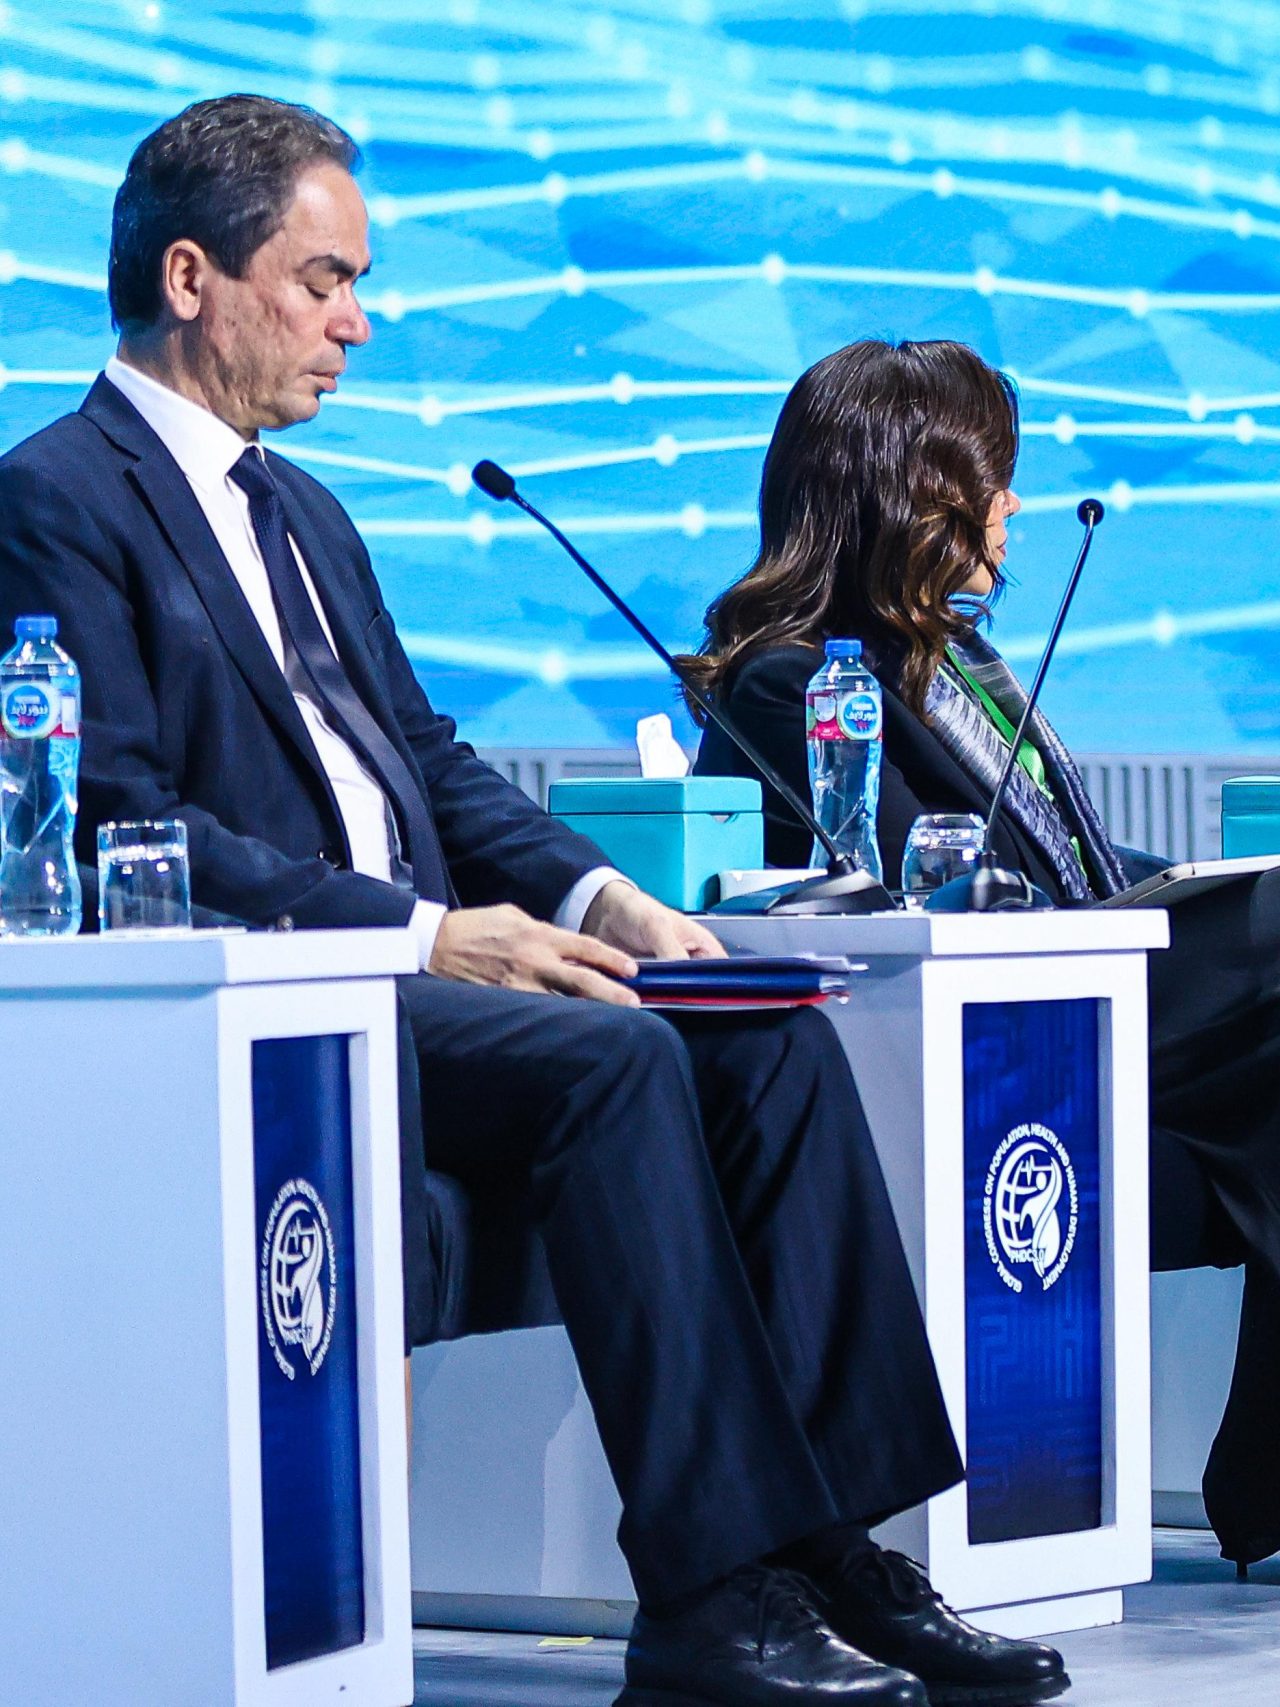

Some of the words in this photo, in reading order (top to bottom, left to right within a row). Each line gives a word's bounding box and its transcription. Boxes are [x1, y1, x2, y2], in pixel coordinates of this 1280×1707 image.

[1031, 1123, 1058, 1147] HEALTH
[1055, 1143, 1070, 1167] AND
[985, 1174, 995, 1196] ON
[1066, 1167, 1078, 1214] HUMAN
[983, 1197, 999, 1264] CONGRESS
[1042, 1215, 1077, 1291] DEVELOPMENT
[997, 1262, 1023, 1293] GLOBAL
